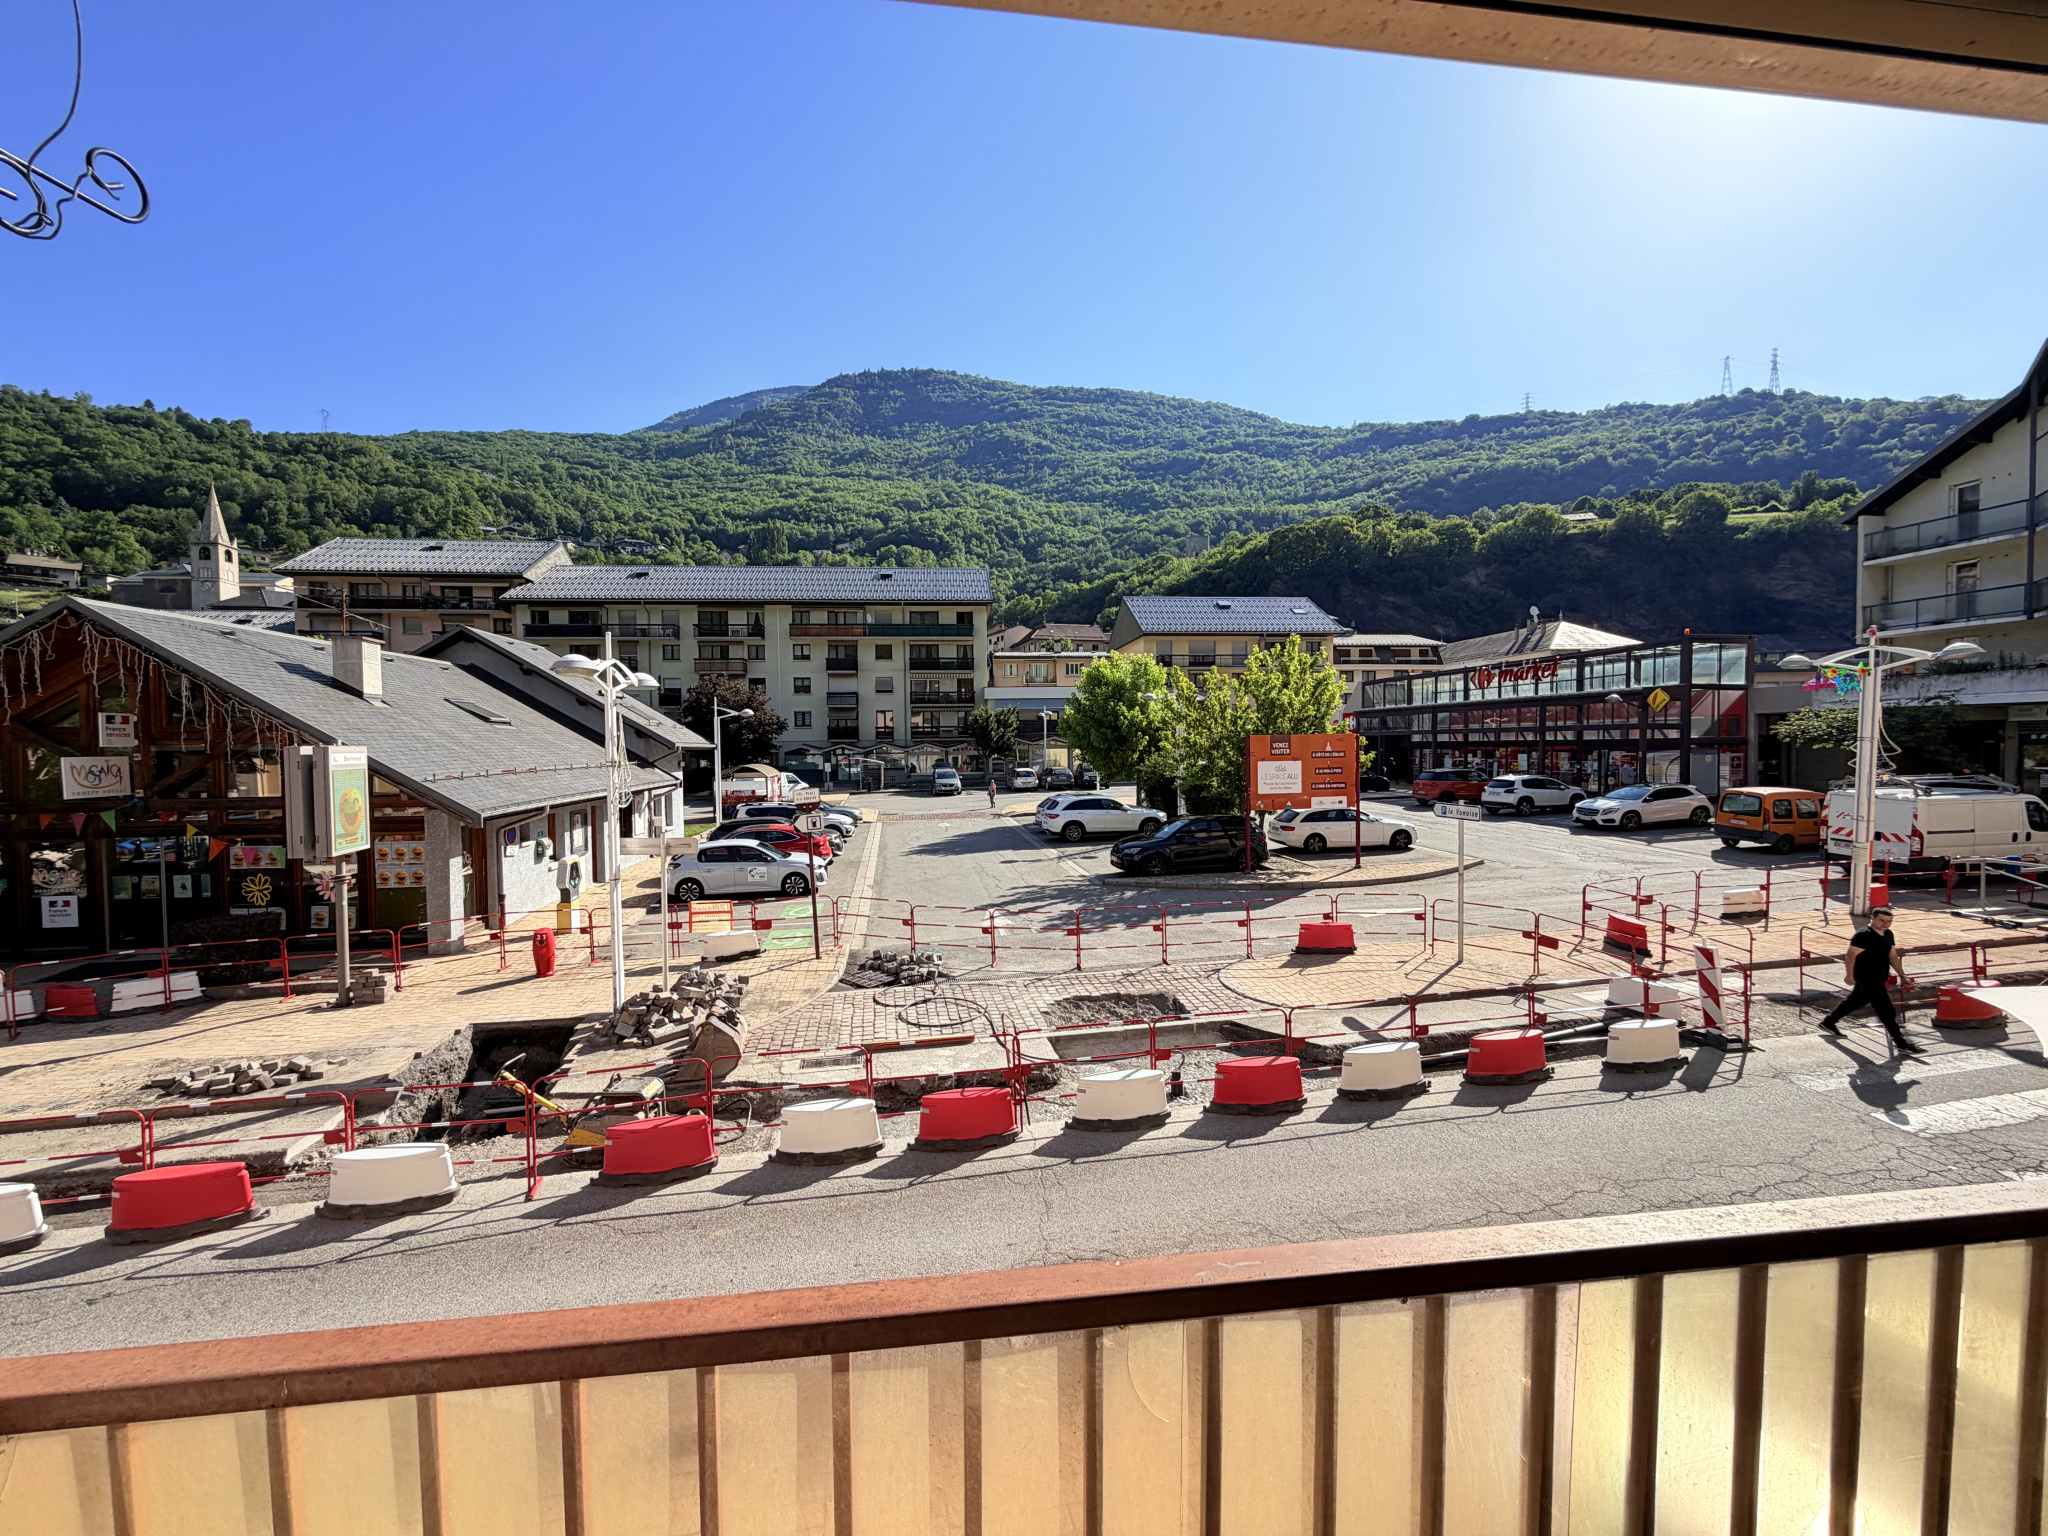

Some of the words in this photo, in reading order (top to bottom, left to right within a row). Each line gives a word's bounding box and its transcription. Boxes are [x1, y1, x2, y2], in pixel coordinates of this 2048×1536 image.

[1498, 655, 1560, 683] market
[103, 787, 127, 795] social
[1456, 809, 1479, 817] Vanoise
